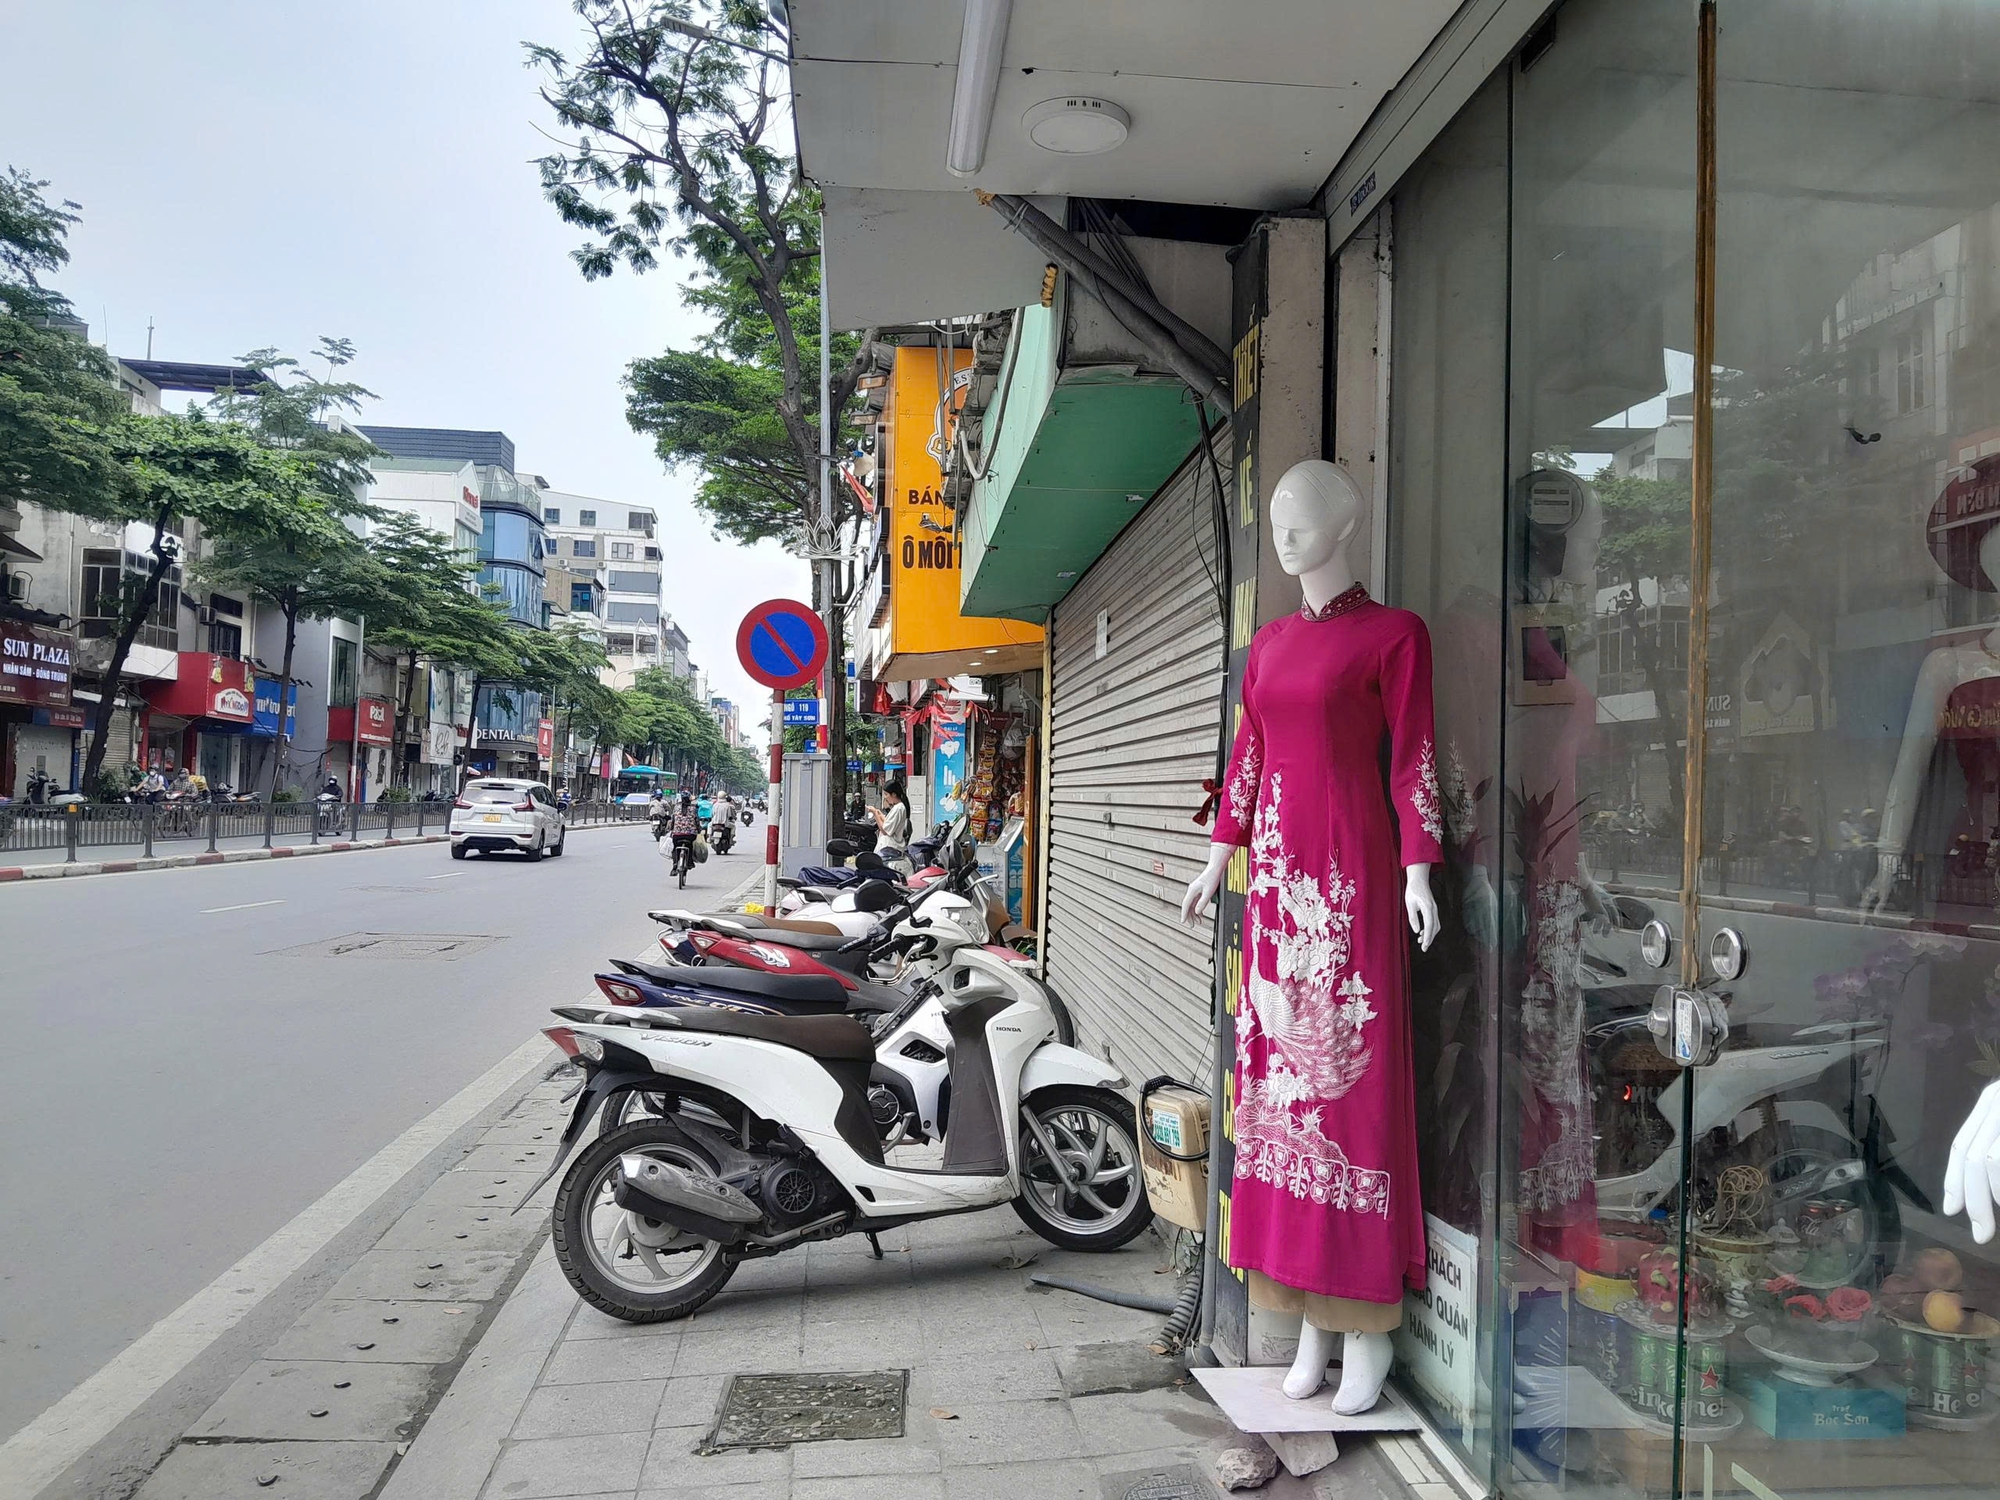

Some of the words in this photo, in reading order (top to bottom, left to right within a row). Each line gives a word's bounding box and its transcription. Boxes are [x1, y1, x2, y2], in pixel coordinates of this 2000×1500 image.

[902, 535, 914, 569] Ô
[3, 638, 30, 658] SUN
[32, 643, 70, 665] PLAZA
[476, 729, 516, 741] DENTAL
[639, 1032, 713, 1048] VISION
[1436, 1295, 1469, 1341] QUẢN
[1440, 1338, 1455, 1369] LÝ
